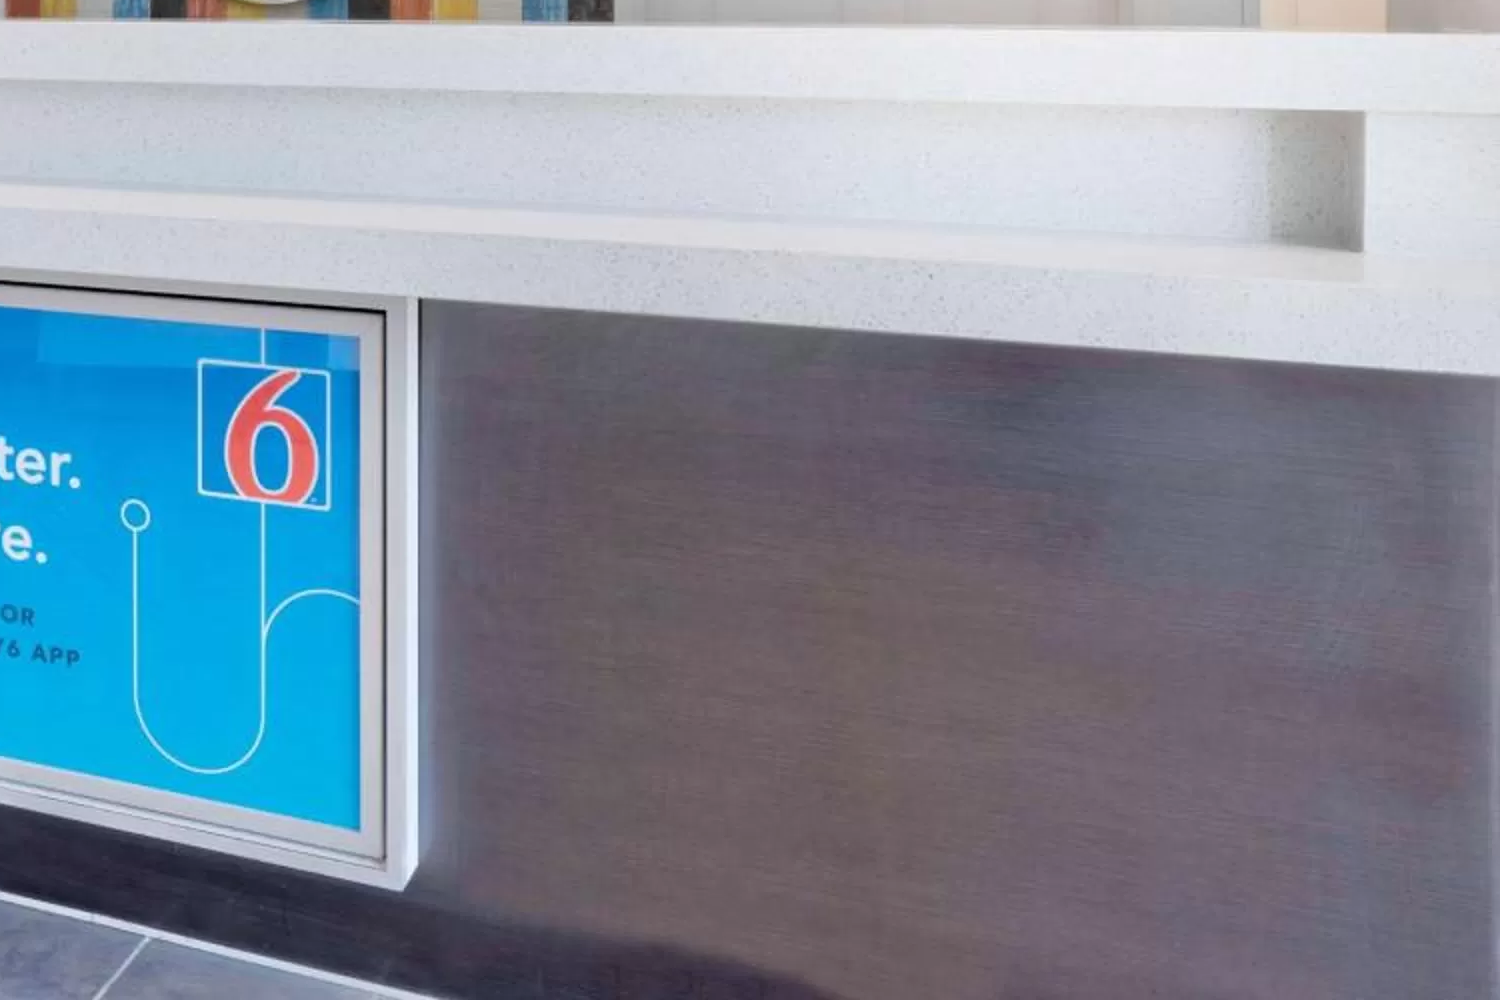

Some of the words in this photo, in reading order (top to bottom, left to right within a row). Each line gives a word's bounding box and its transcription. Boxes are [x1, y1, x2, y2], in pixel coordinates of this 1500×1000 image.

[224, 367, 320, 506] 6
[1, 603, 37, 628] OR
[31, 643, 81, 668] APP
